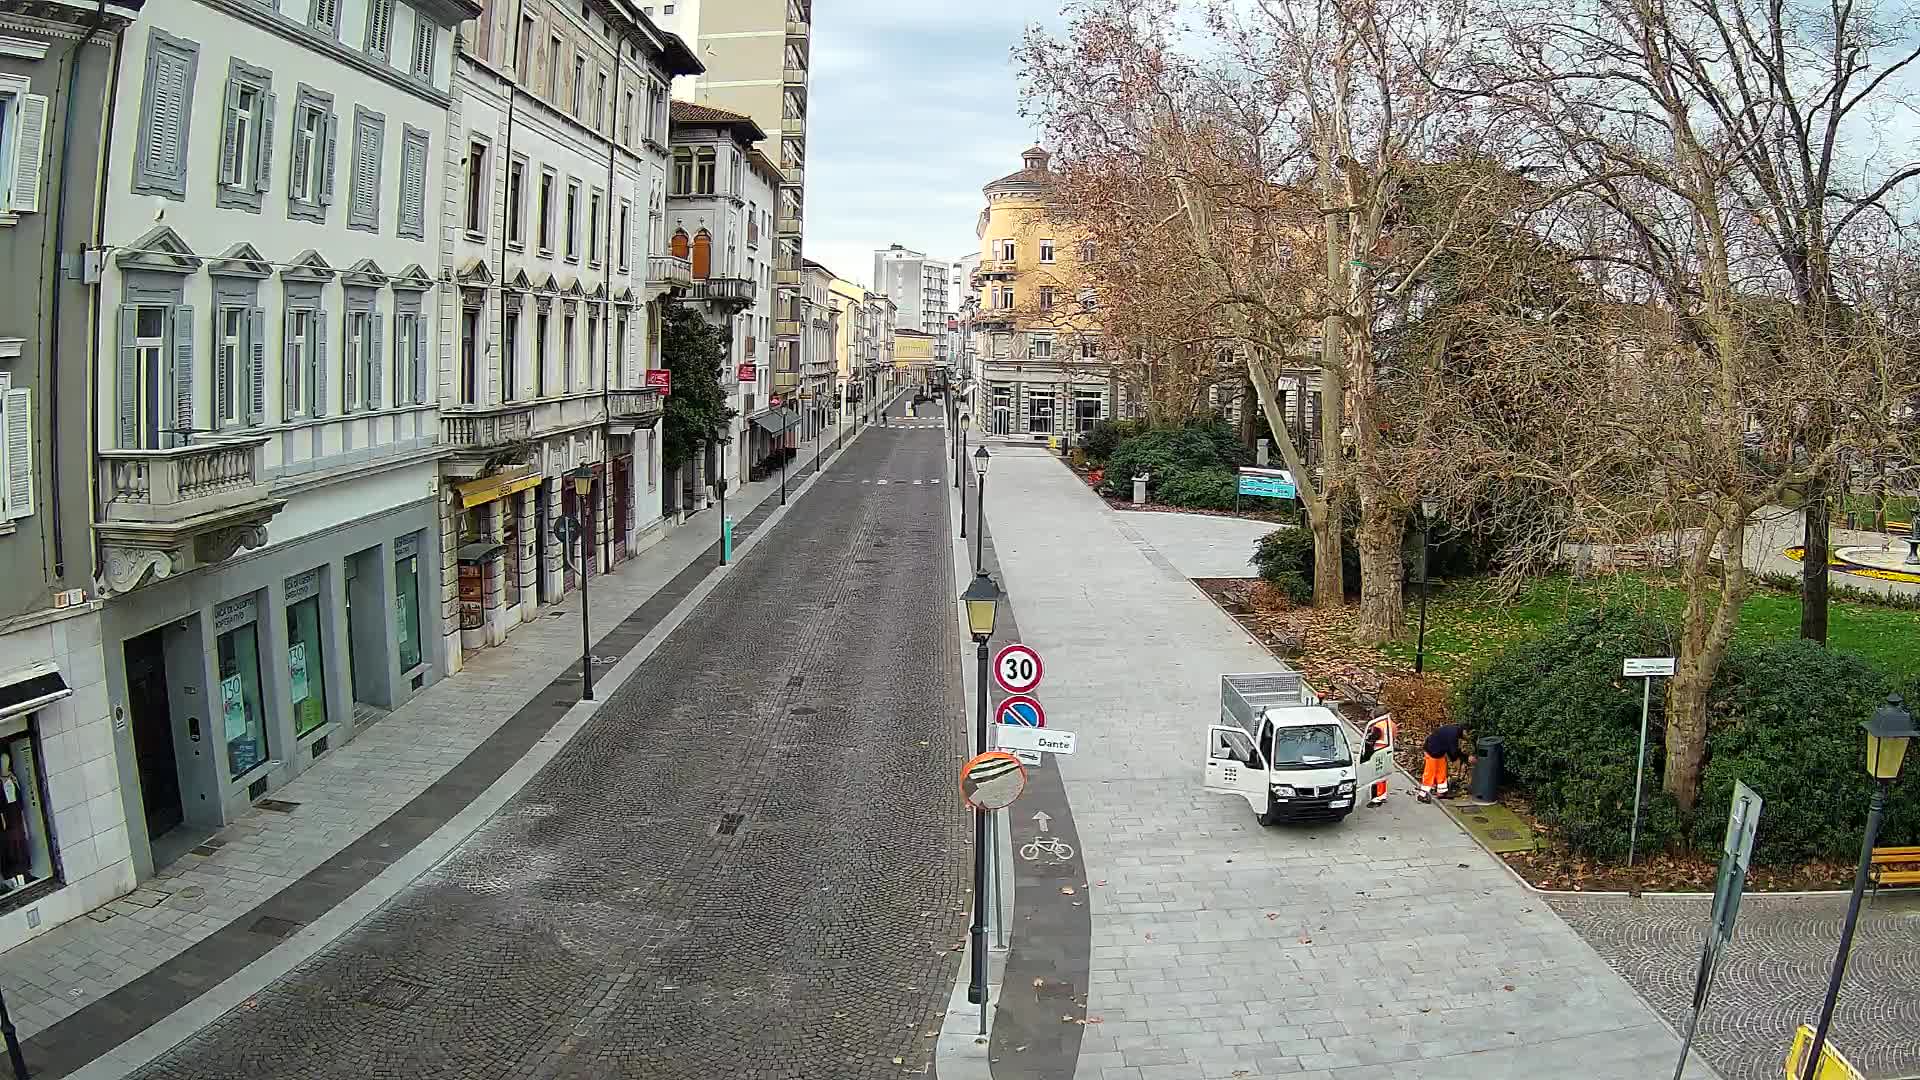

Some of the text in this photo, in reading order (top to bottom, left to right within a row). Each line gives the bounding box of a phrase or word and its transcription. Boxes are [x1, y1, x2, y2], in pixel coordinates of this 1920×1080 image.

[1006, 658, 1032, 680] 30
[222, 677, 240, 701] 130
[1038, 738, 1070, 749] Dante
